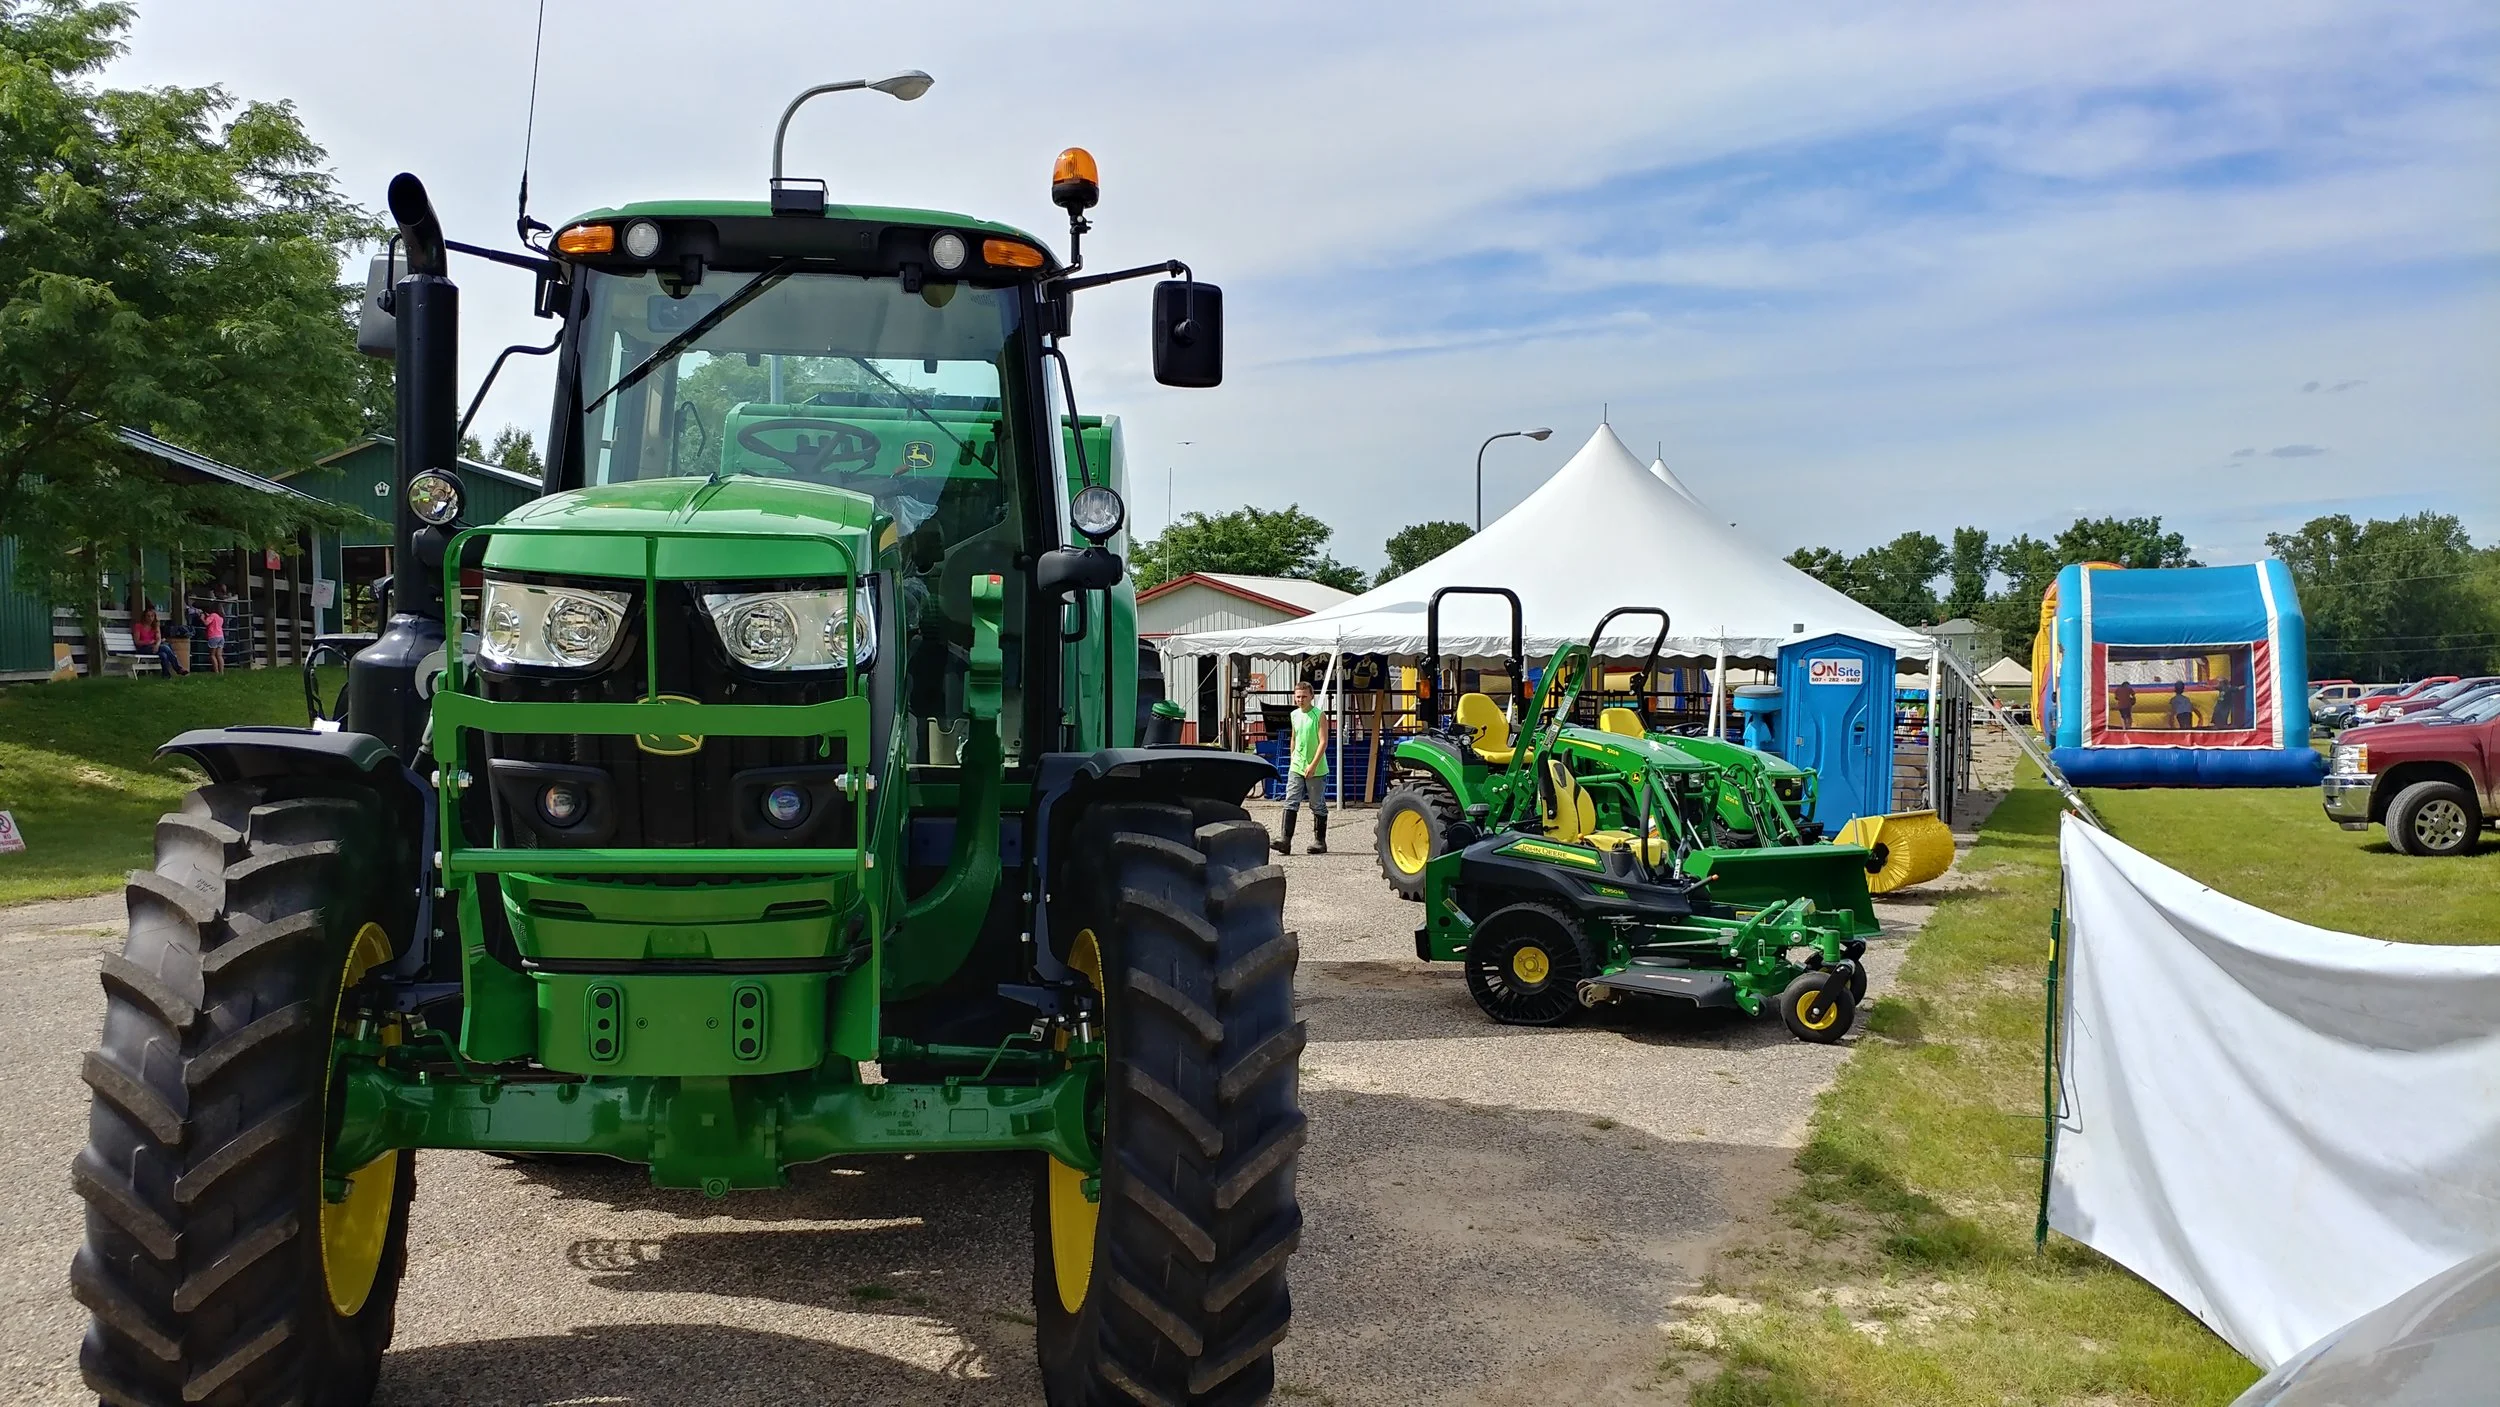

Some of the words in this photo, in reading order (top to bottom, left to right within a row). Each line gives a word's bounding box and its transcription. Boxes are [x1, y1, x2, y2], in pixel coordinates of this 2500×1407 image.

[1302, 653, 1329, 673] FFA
[1314, 668, 1352, 681] BRN
[1520, 844, 1541, 853] JOHN
[1542, 847, 1568, 859] DEERE
